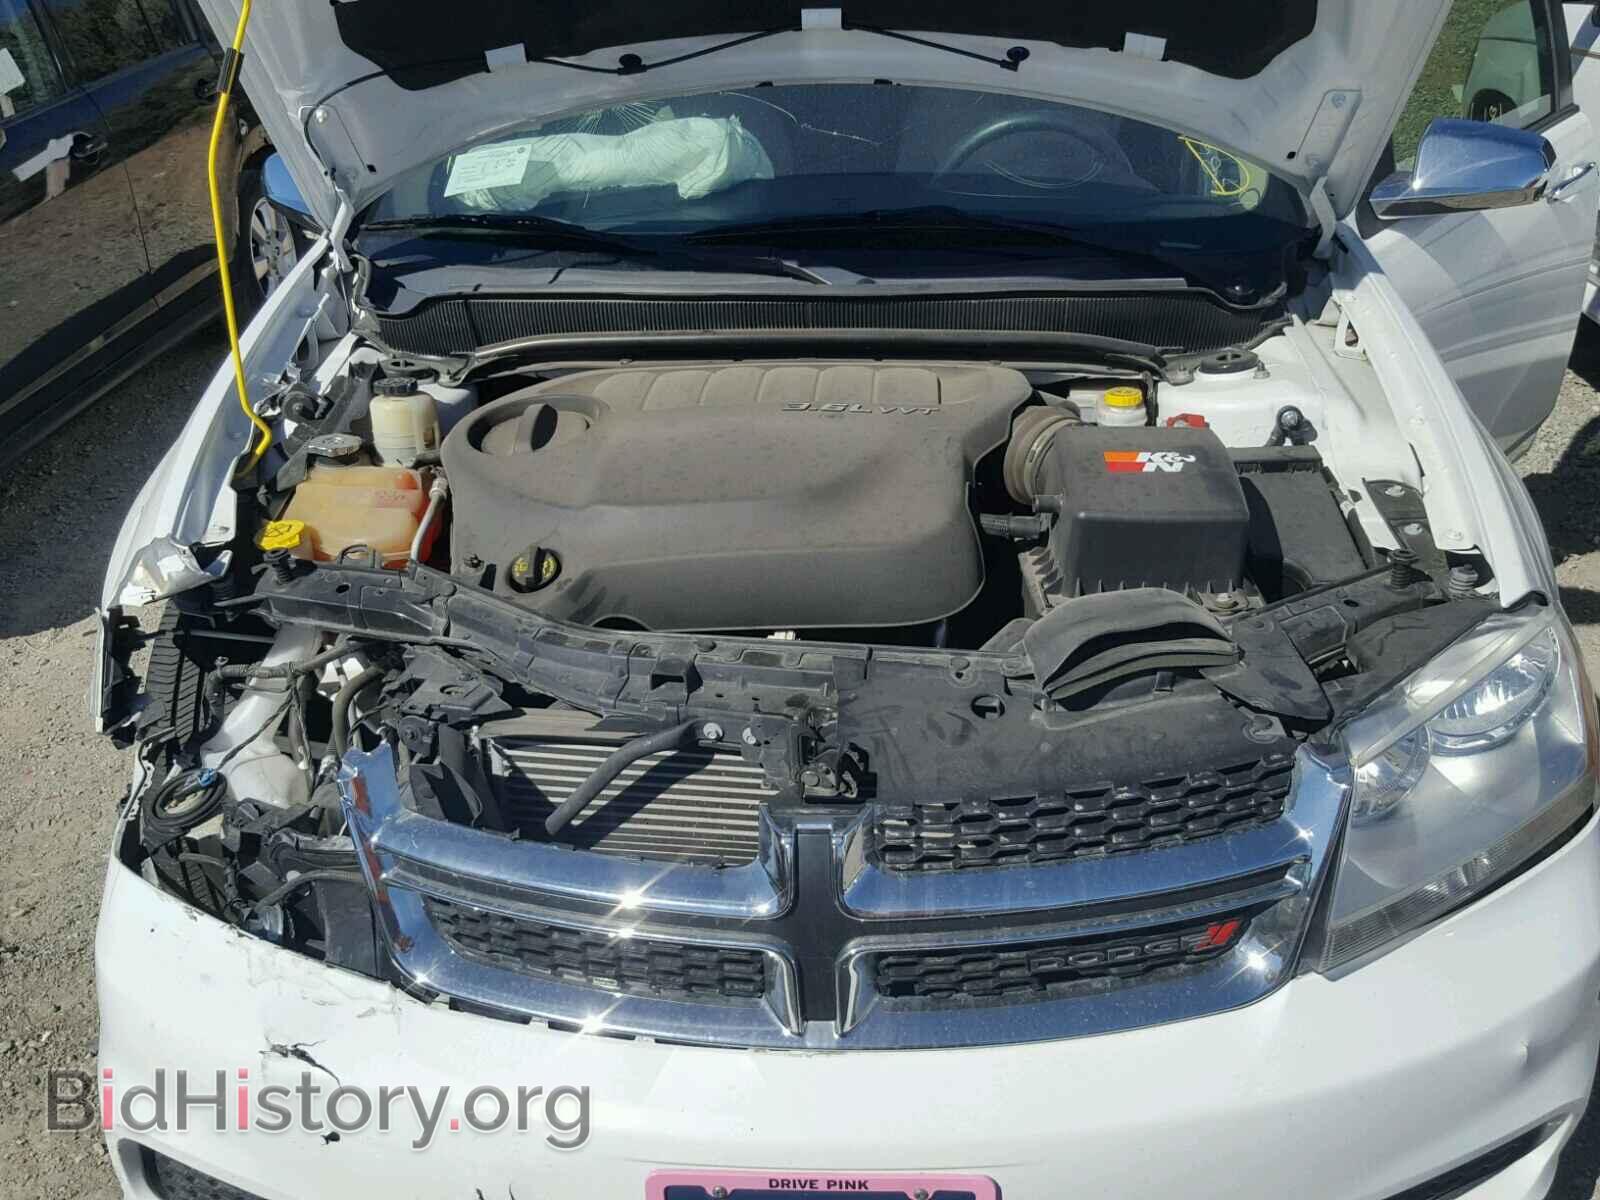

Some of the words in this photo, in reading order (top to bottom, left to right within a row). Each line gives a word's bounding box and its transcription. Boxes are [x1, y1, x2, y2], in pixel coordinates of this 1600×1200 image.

[781, 402, 873, 413] 3.6L
[1135, 451, 1197, 473] K&N
[1026, 933, 1212, 974] DODGE
[768, 1178, 819, 1189] DRIVE
[826, 1179, 869, 1190] PINK
